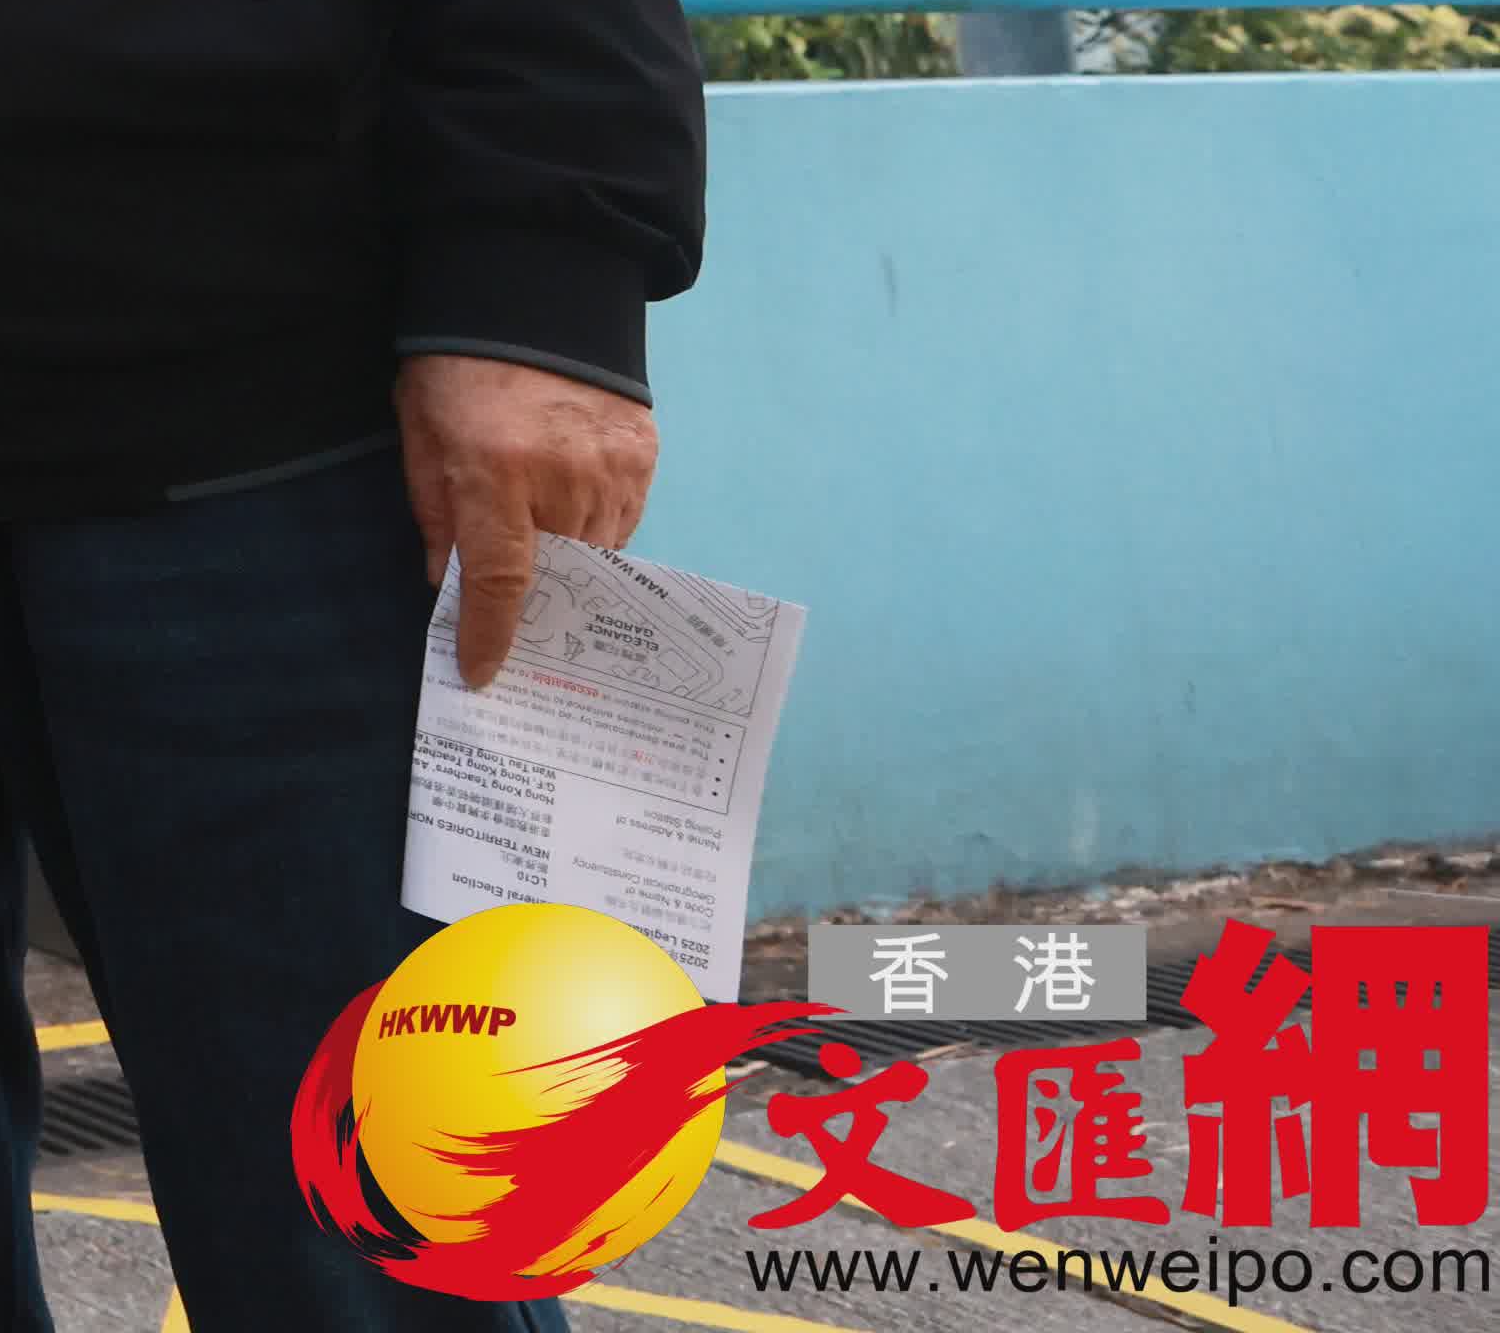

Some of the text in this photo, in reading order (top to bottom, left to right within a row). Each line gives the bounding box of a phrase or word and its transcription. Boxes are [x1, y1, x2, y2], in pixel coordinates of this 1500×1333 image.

[598, 543, 669, 603] NAM WAN
[593, 612, 654, 637] GARDEN
[581, 620, 661, 652] ELEGANCE
[475, 748, 505, 765] Tong
[465, 758, 498, 776] Kong
[530, 765, 557, 779] Wan
[498, 768, 531, 786] Hong
[490, 778, 523, 797] Kong
[523, 787, 555, 805] Hong
[407, 810, 551, 860] NEW TERRITORIES NOR
[449, 871, 504, 897] Election
[514, 869, 549, 887] LC10
[678, 937, 710, 955] 2025
